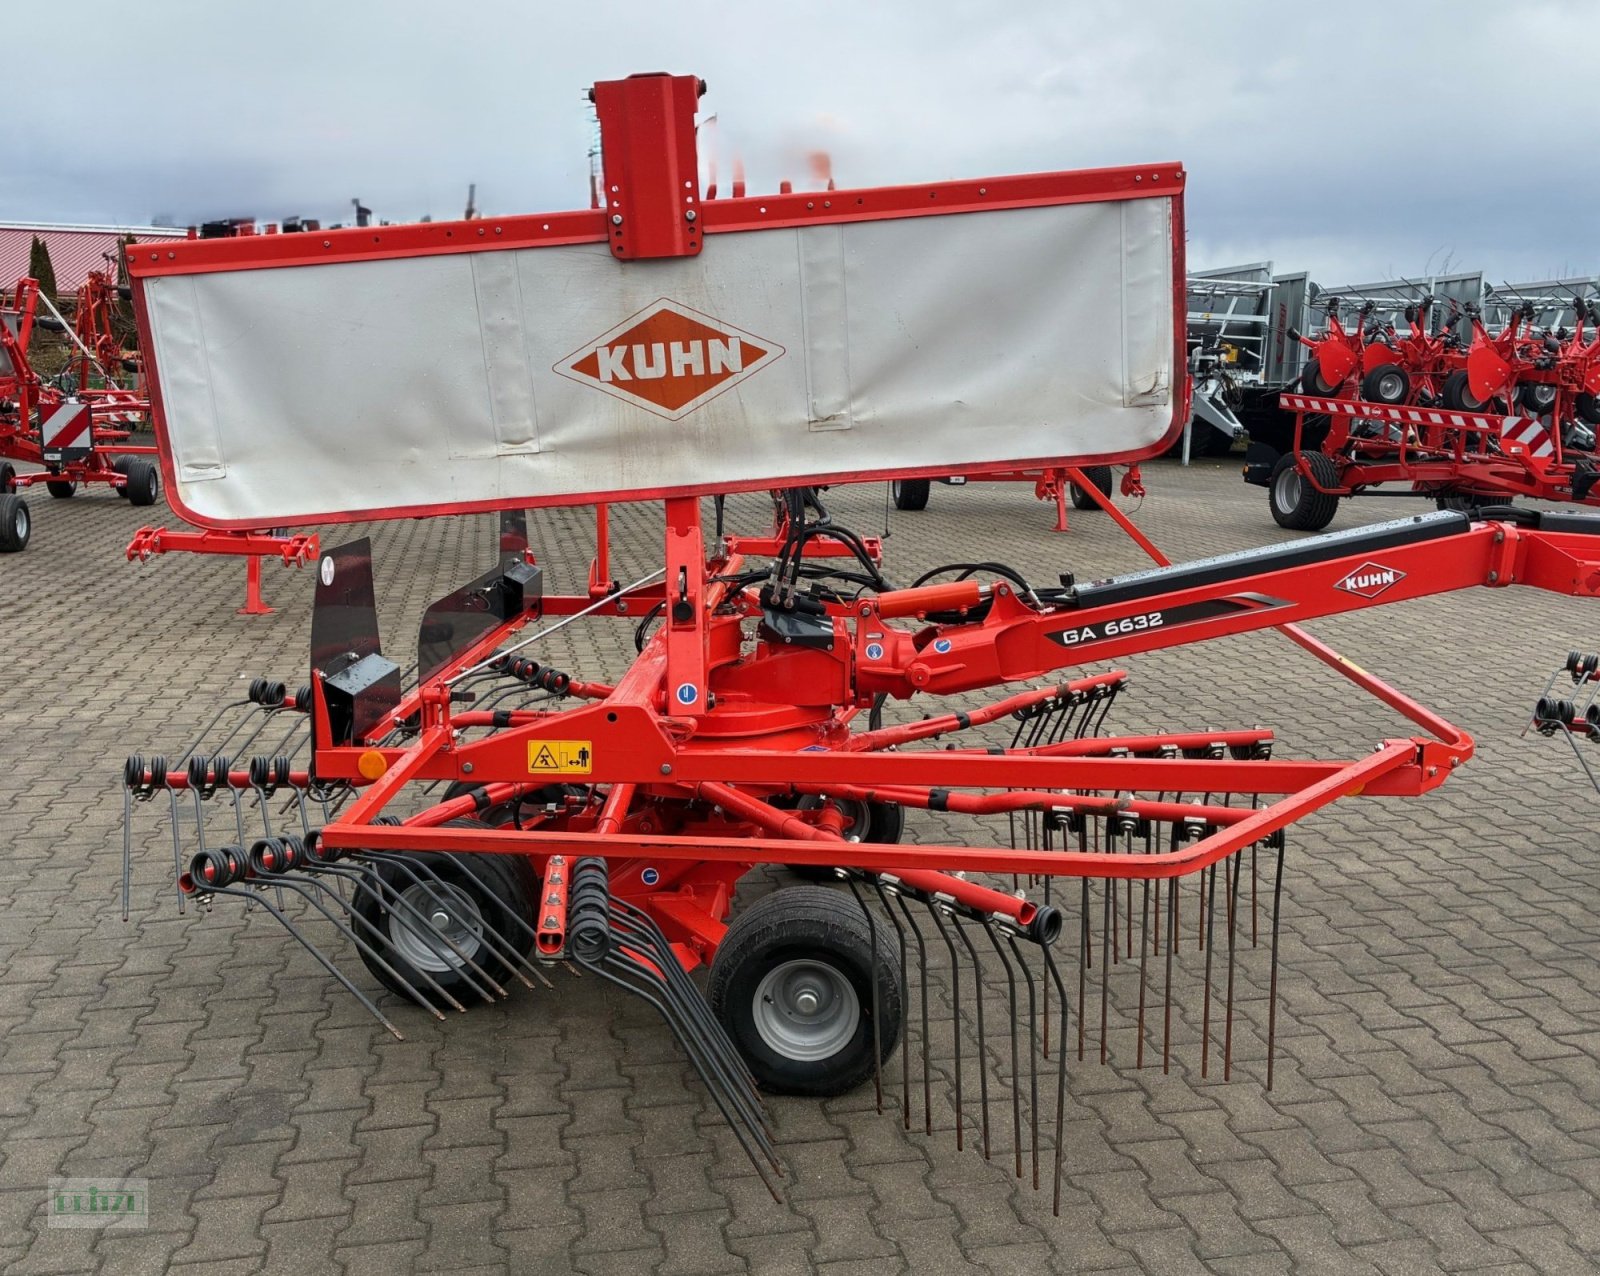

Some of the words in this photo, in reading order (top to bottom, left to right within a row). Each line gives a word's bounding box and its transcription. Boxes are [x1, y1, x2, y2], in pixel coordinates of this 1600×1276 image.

[596, 336, 743, 382] KUHN
[1346, 571, 1395, 590] KUHN
[1062, 627, 1097, 644] GA
[1104, 612, 1163, 636] 6632
